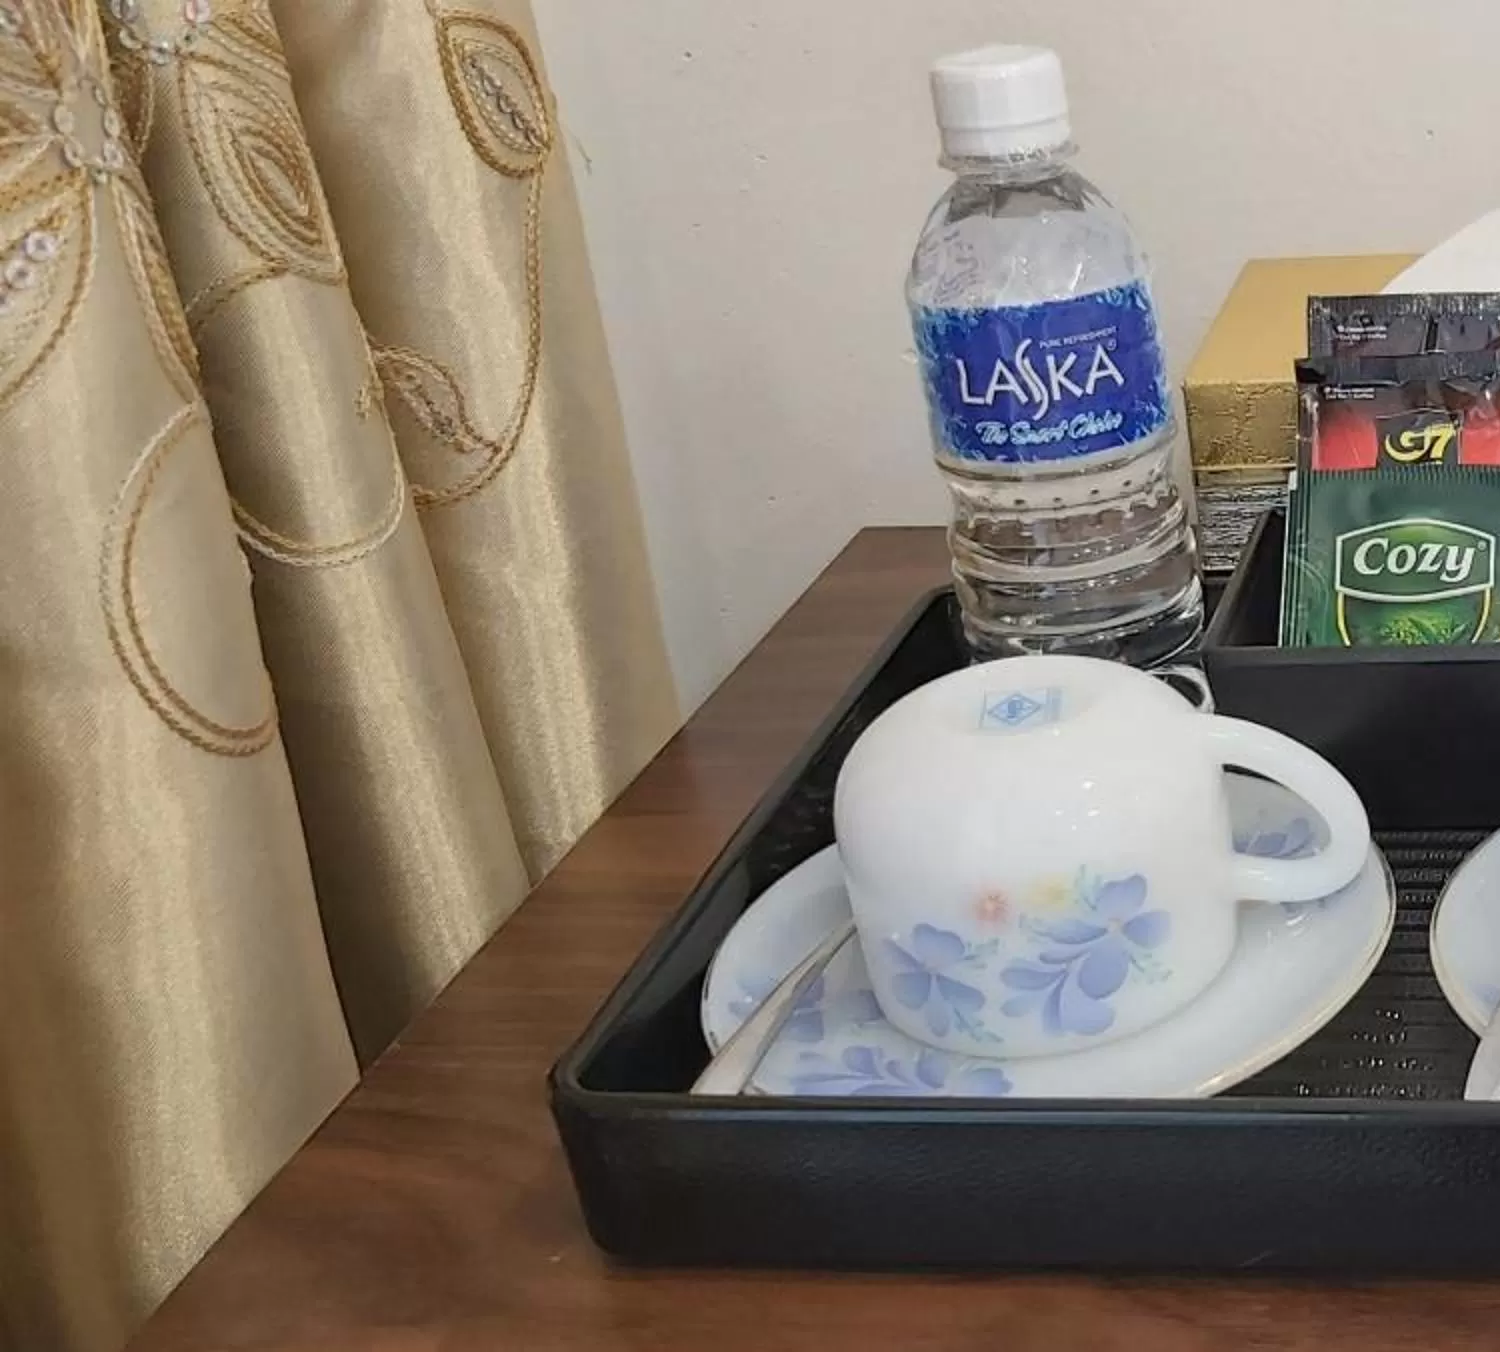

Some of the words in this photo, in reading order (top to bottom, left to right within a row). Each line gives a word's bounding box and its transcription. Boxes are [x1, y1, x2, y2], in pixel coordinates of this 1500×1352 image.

[956, 338, 1125, 421] LASKA
[975, 420, 1007, 446] The
[1008, 418, 1068, 446] Smart
[1384, 422, 1457, 461] G7
[1353, 536, 1475, 584] Cozy
